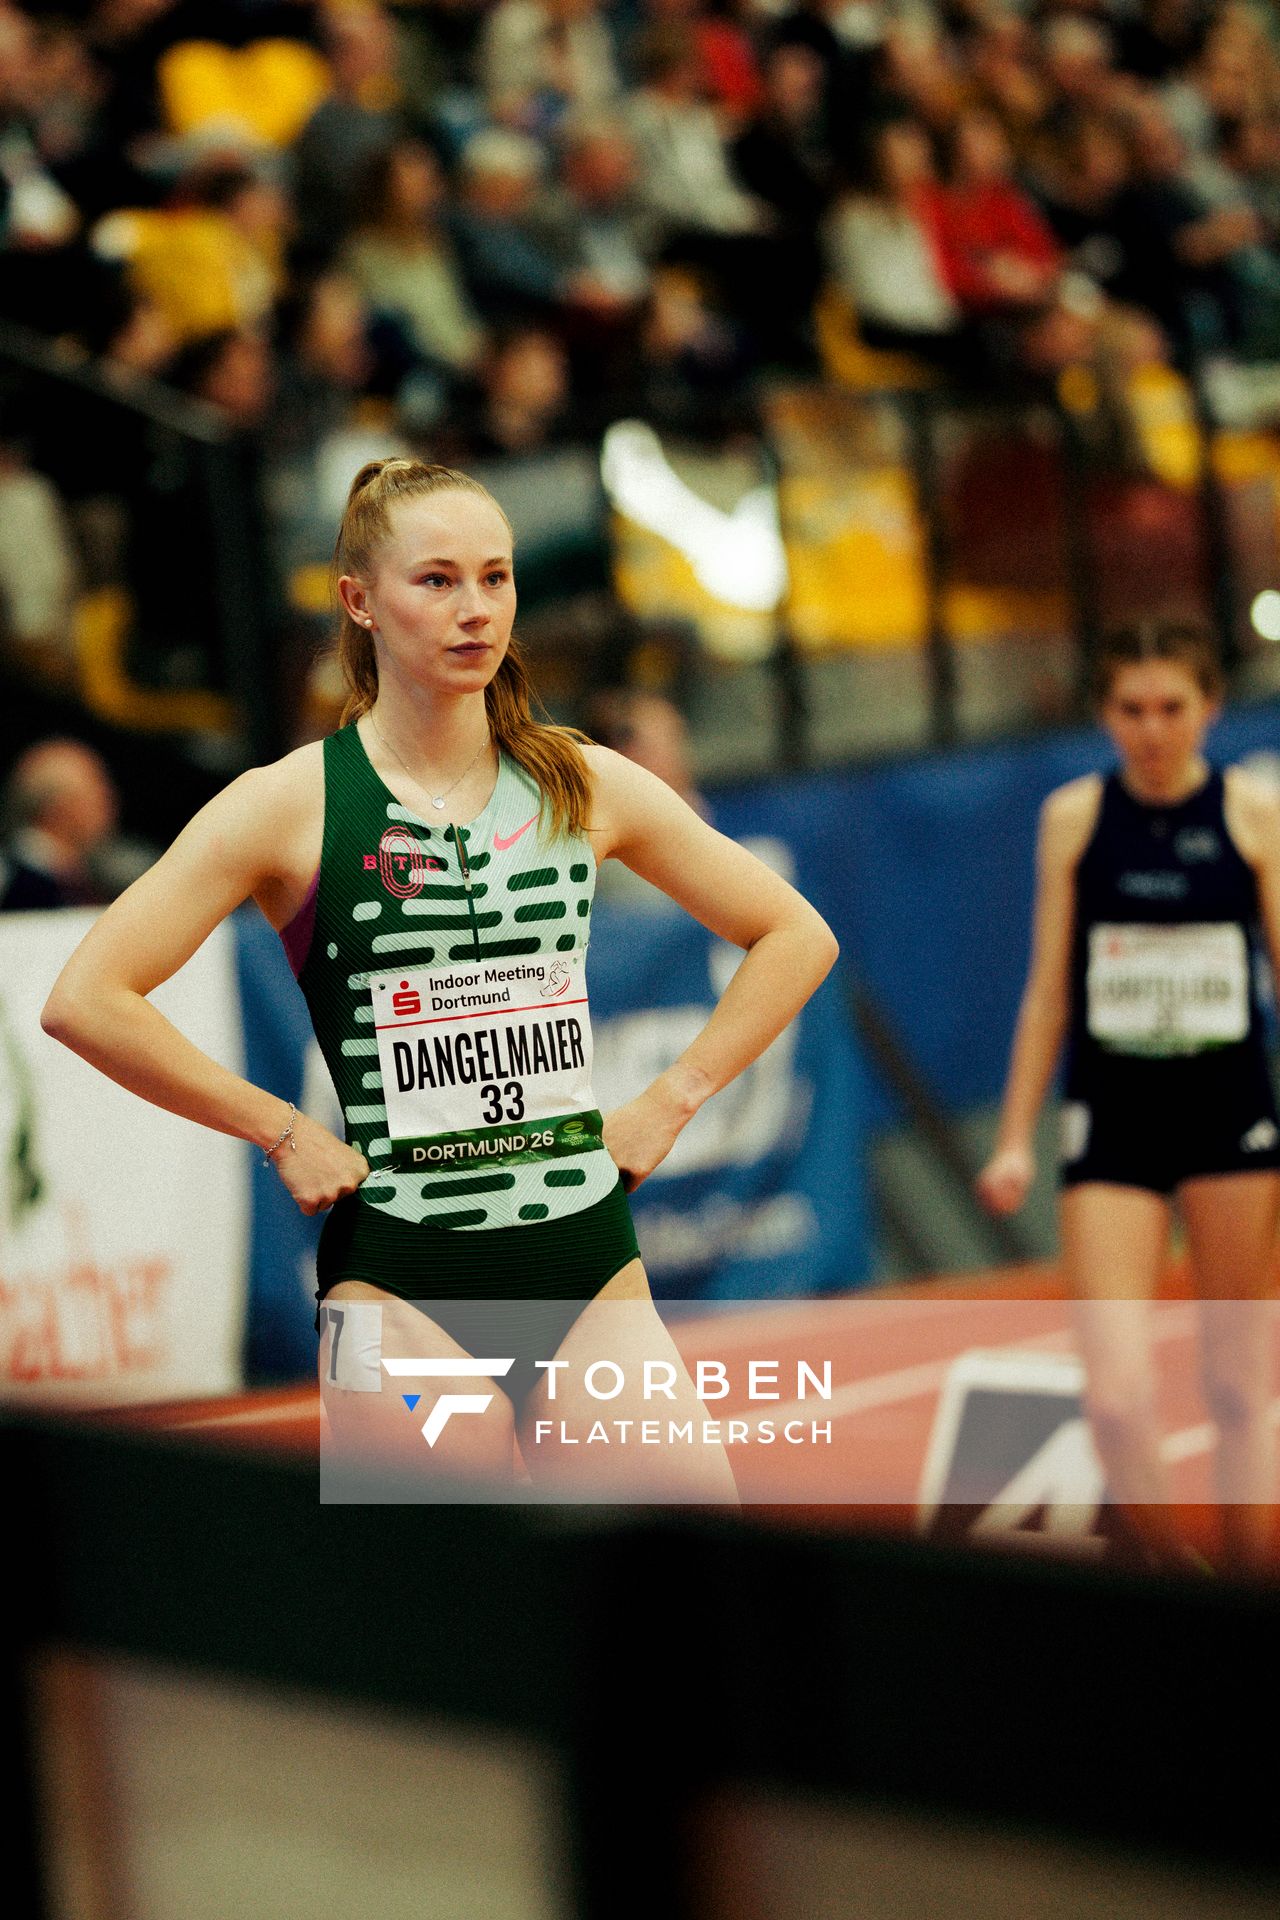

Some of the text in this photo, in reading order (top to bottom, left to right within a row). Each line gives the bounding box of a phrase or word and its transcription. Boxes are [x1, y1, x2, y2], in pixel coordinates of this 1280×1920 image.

[429, 965, 545, 991] Indoor Meeting
[432, 988, 510, 1011] Dortmund
[393, 1018, 585, 1093] DANGELMAIER
[480, 1082, 525, 1124] 33
[413, 1134, 526, 1162] DORTMUND
[530, 1130, 554, 1148] 26
[329, 1308, 344, 1380] 7
[970, 1418, 1107, 1558] 4
